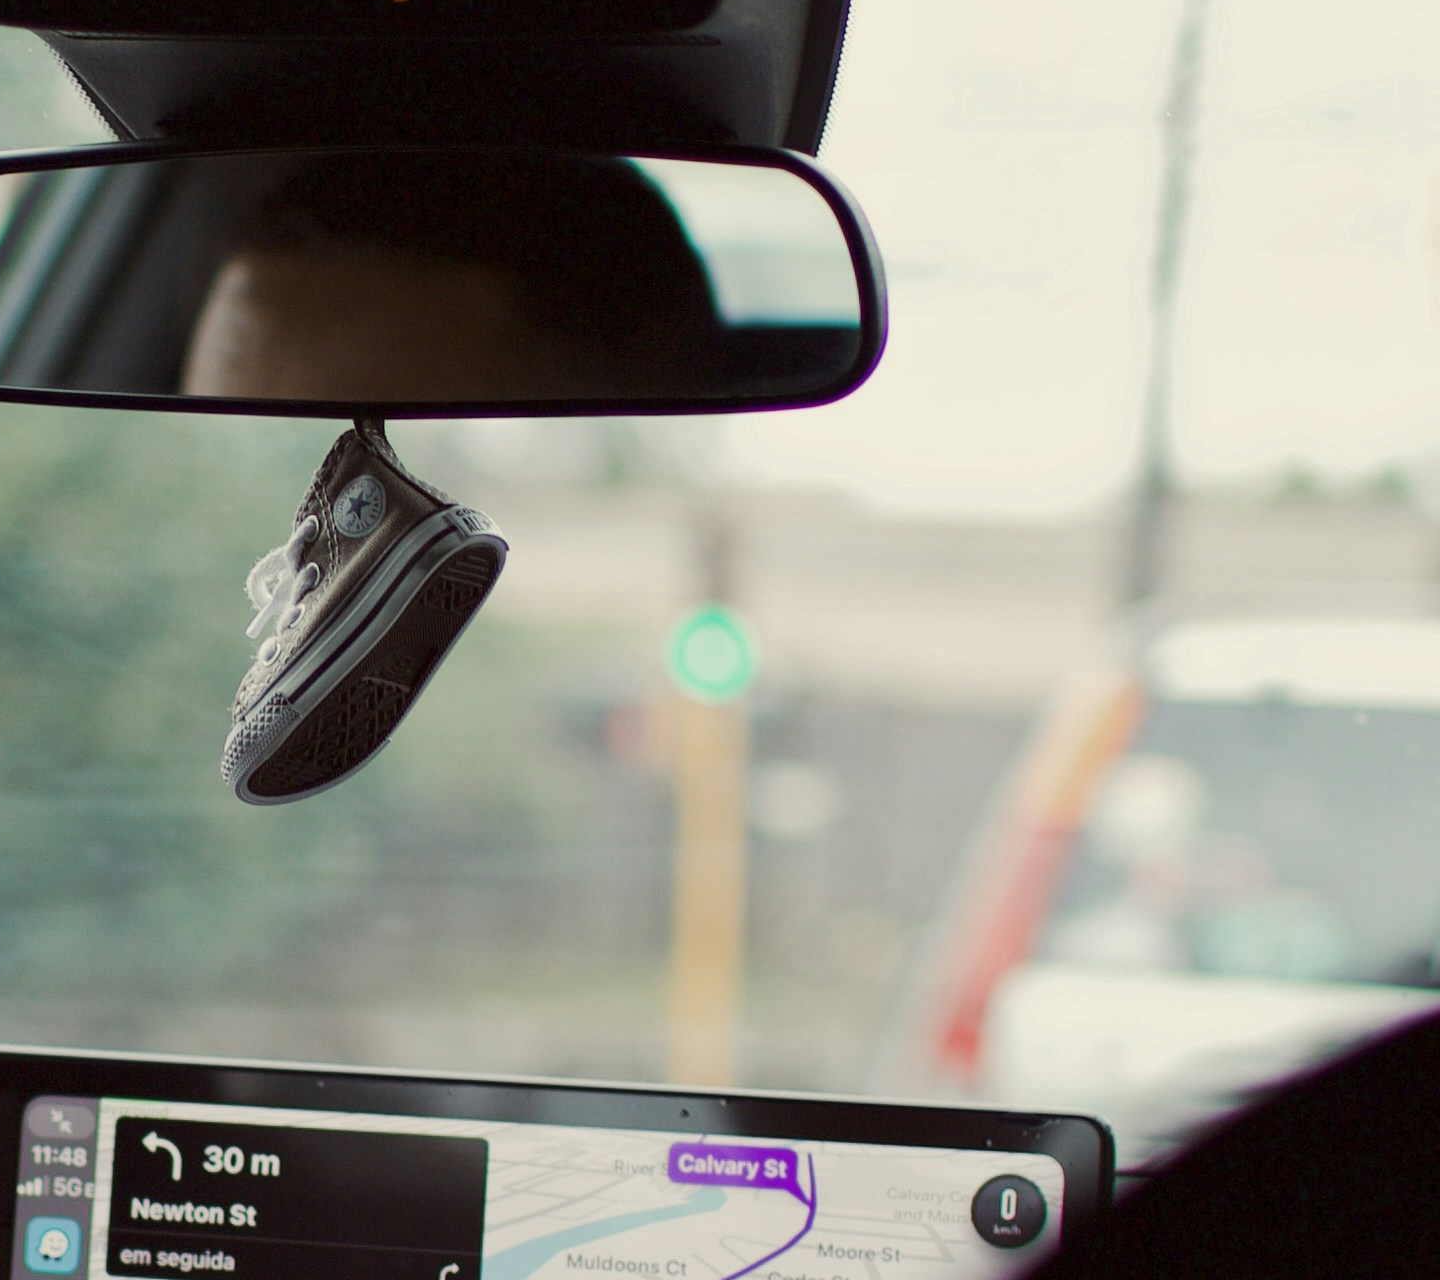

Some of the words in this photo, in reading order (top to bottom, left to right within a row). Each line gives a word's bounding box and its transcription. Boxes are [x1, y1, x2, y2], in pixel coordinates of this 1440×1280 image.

[32, 1145, 87, 1167] 11:48
[203, 1144, 245, 1174] 30
[250, 1153, 280, 1177] m
[677, 1152, 759, 1182] Calvary
[763, 1158, 788, 1180] St
[130, 1197, 224, 1225] Newton
[229, 1203, 257, 1228] St
[1001, 1187, 1018, 1221] 0
[119, 1248, 152, 1265] em
[157, 1250, 236, 1273] seguida
[566, 1253, 661, 1276] Muldoons
[665, 1259, 687, 1277] Ct
[817, 1242, 877, 1261] Moore
[881, 1246, 902, 1263] St
